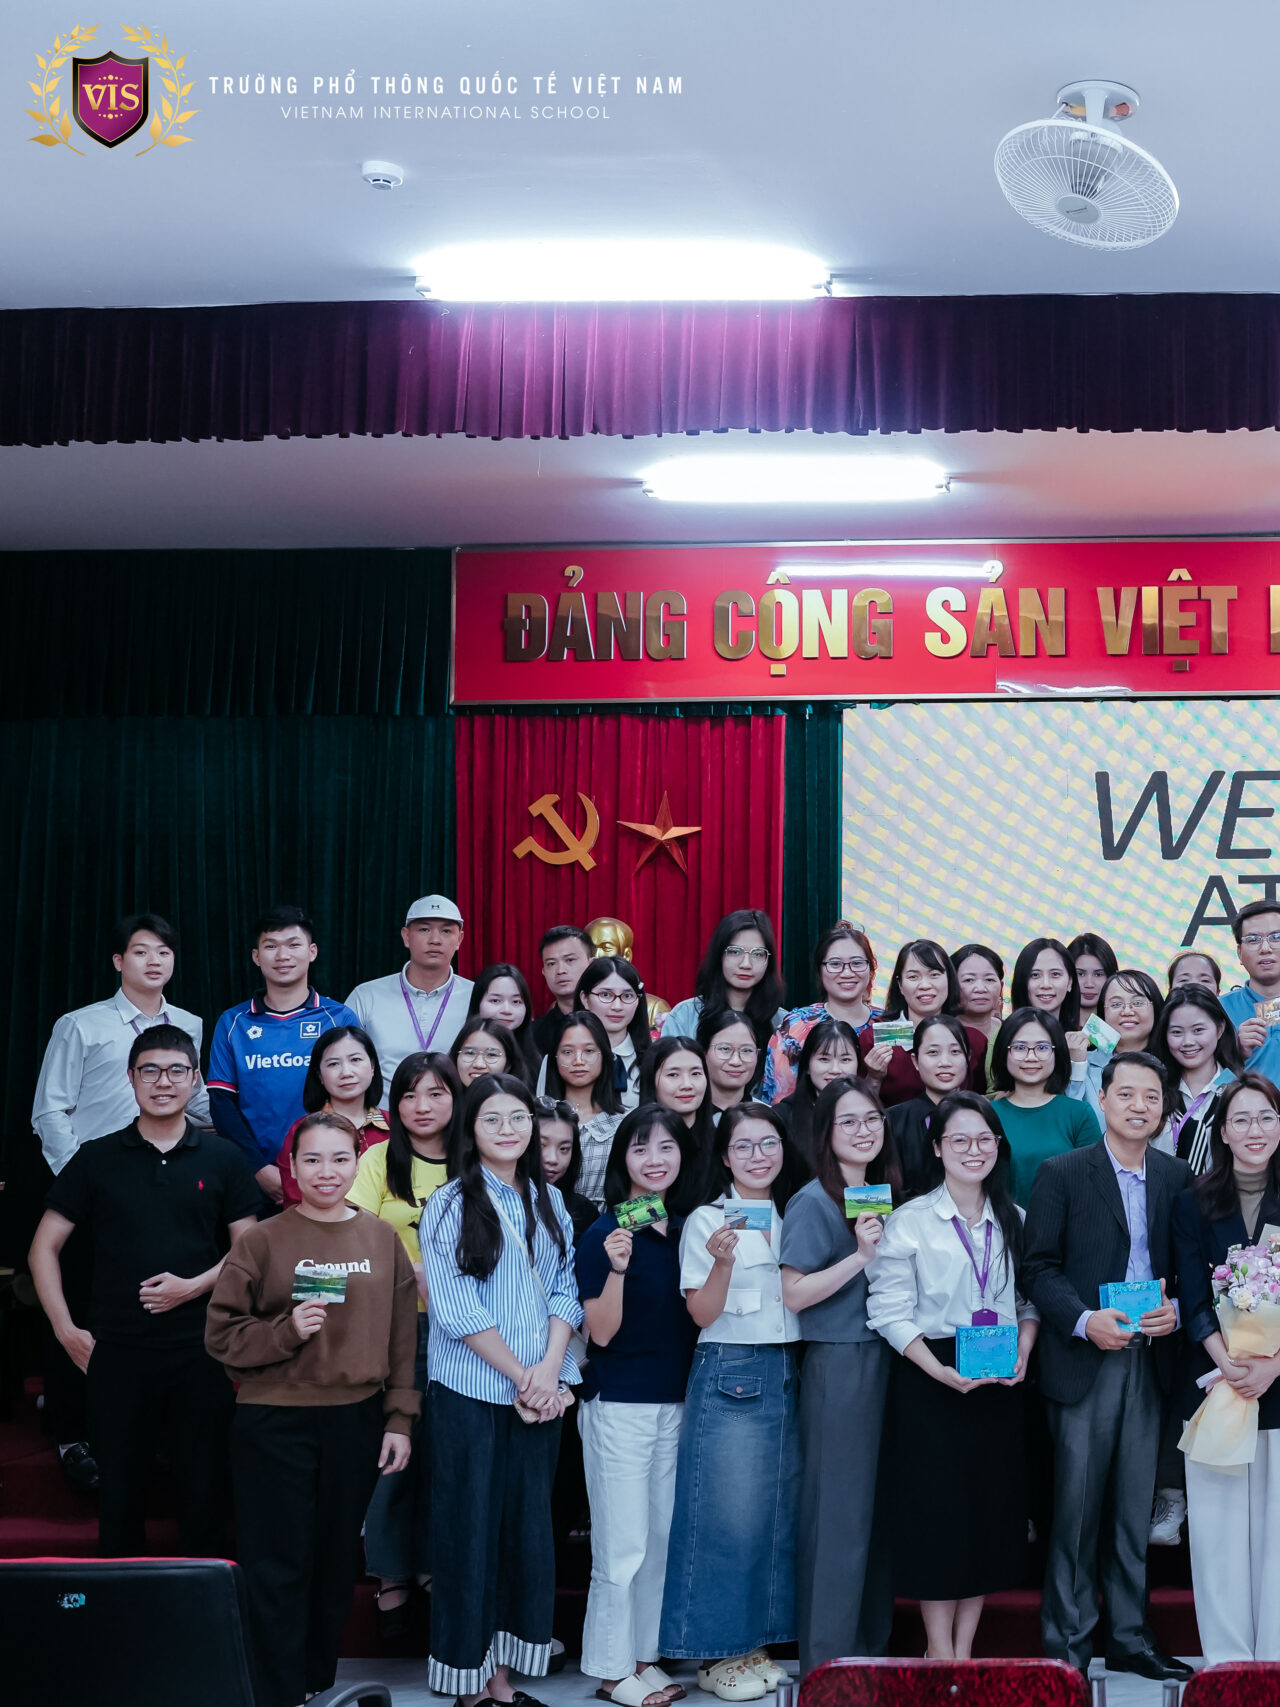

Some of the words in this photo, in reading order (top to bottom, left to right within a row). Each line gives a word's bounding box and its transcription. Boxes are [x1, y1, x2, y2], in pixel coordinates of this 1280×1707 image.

[503, 564, 687, 662] ĐẢNG
[713, 571, 894, 677] CỘNG
[924, 560, 1067, 658] SẢN
[1096, 568, 1238, 672] VIỆT
[245, 1052, 312, 1070] VietGoa
